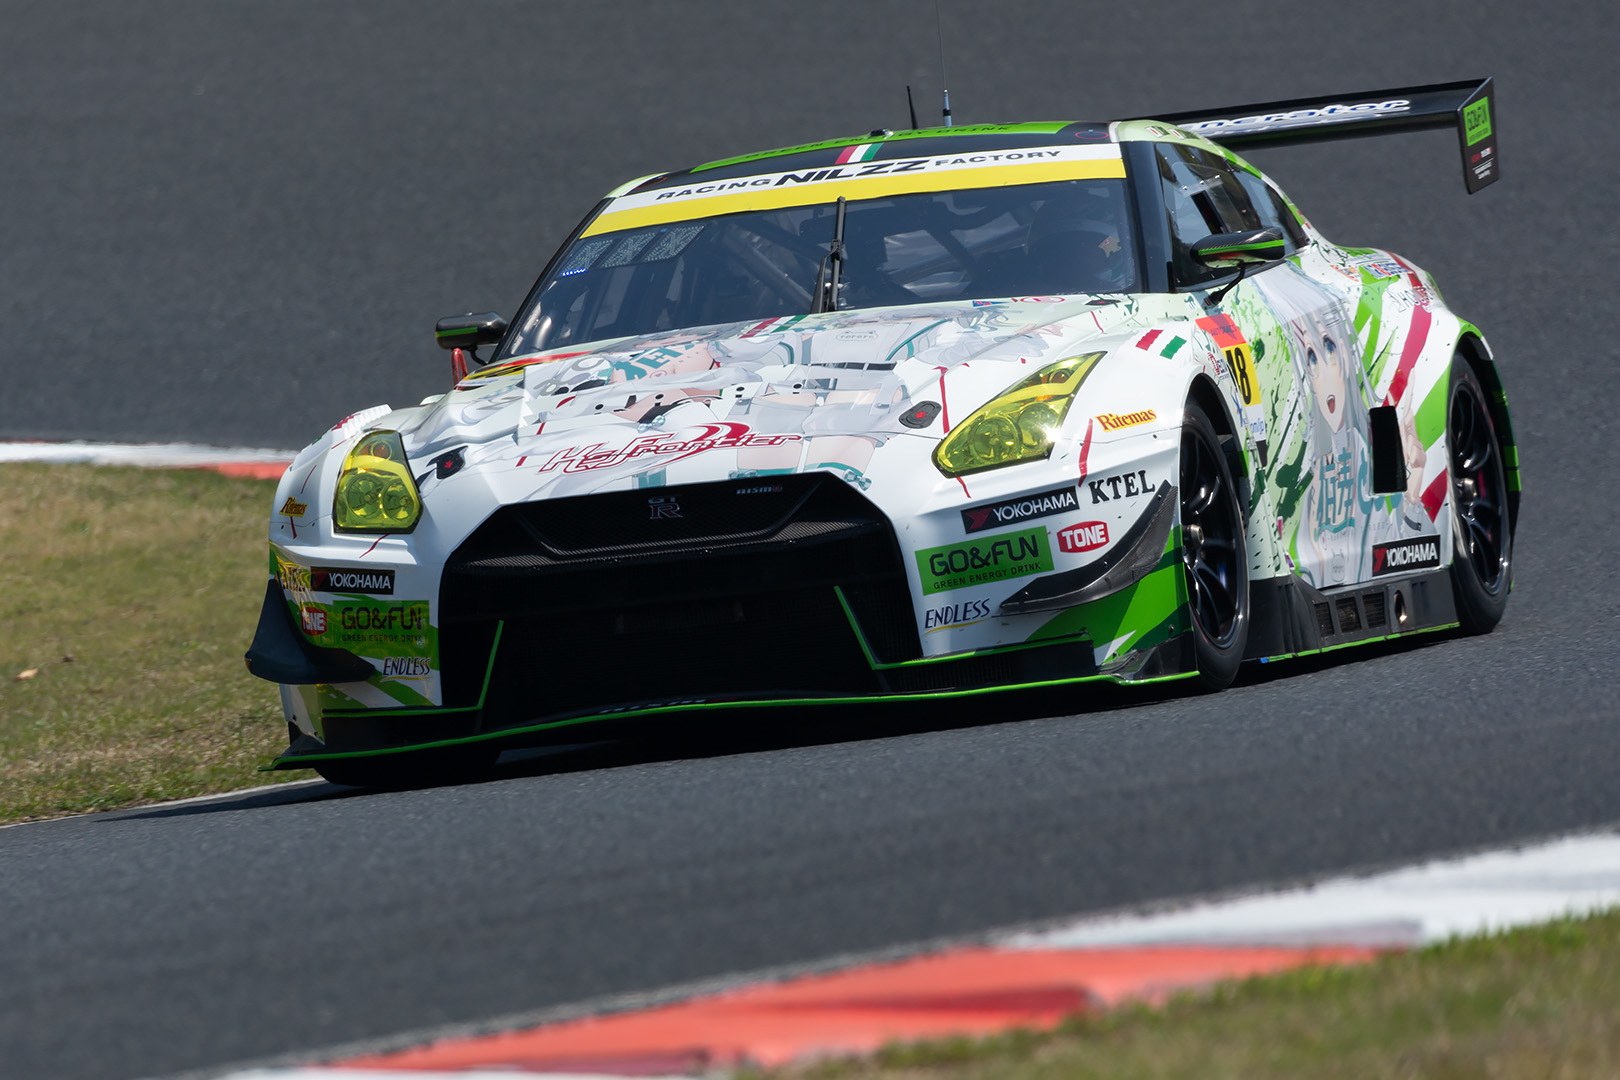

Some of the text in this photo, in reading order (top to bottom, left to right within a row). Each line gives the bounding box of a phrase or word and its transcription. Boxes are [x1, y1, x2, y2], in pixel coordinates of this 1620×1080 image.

[655, 150, 1061, 201] RACING NILZZ FACTORY
[1096, 408, 1157, 432] Ritemas
[1087, 470, 1156, 505] KTEL
[992, 491, 1076, 522] YOKOHAMA
[1062, 524, 1107, 550] TONE
[928, 534, 1040, 578] GO&FUN
[1386, 543, 1438, 568] YOKOHAMA
[328, 572, 391, 590] YOKOHAMA
[933, 562, 1041, 590] GREEN ENERGY DRINK
[341, 606, 422, 630] GO&FUN
[925, 598, 990, 629] ENDLESS
[382, 656, 431, 677] ENDLESS
